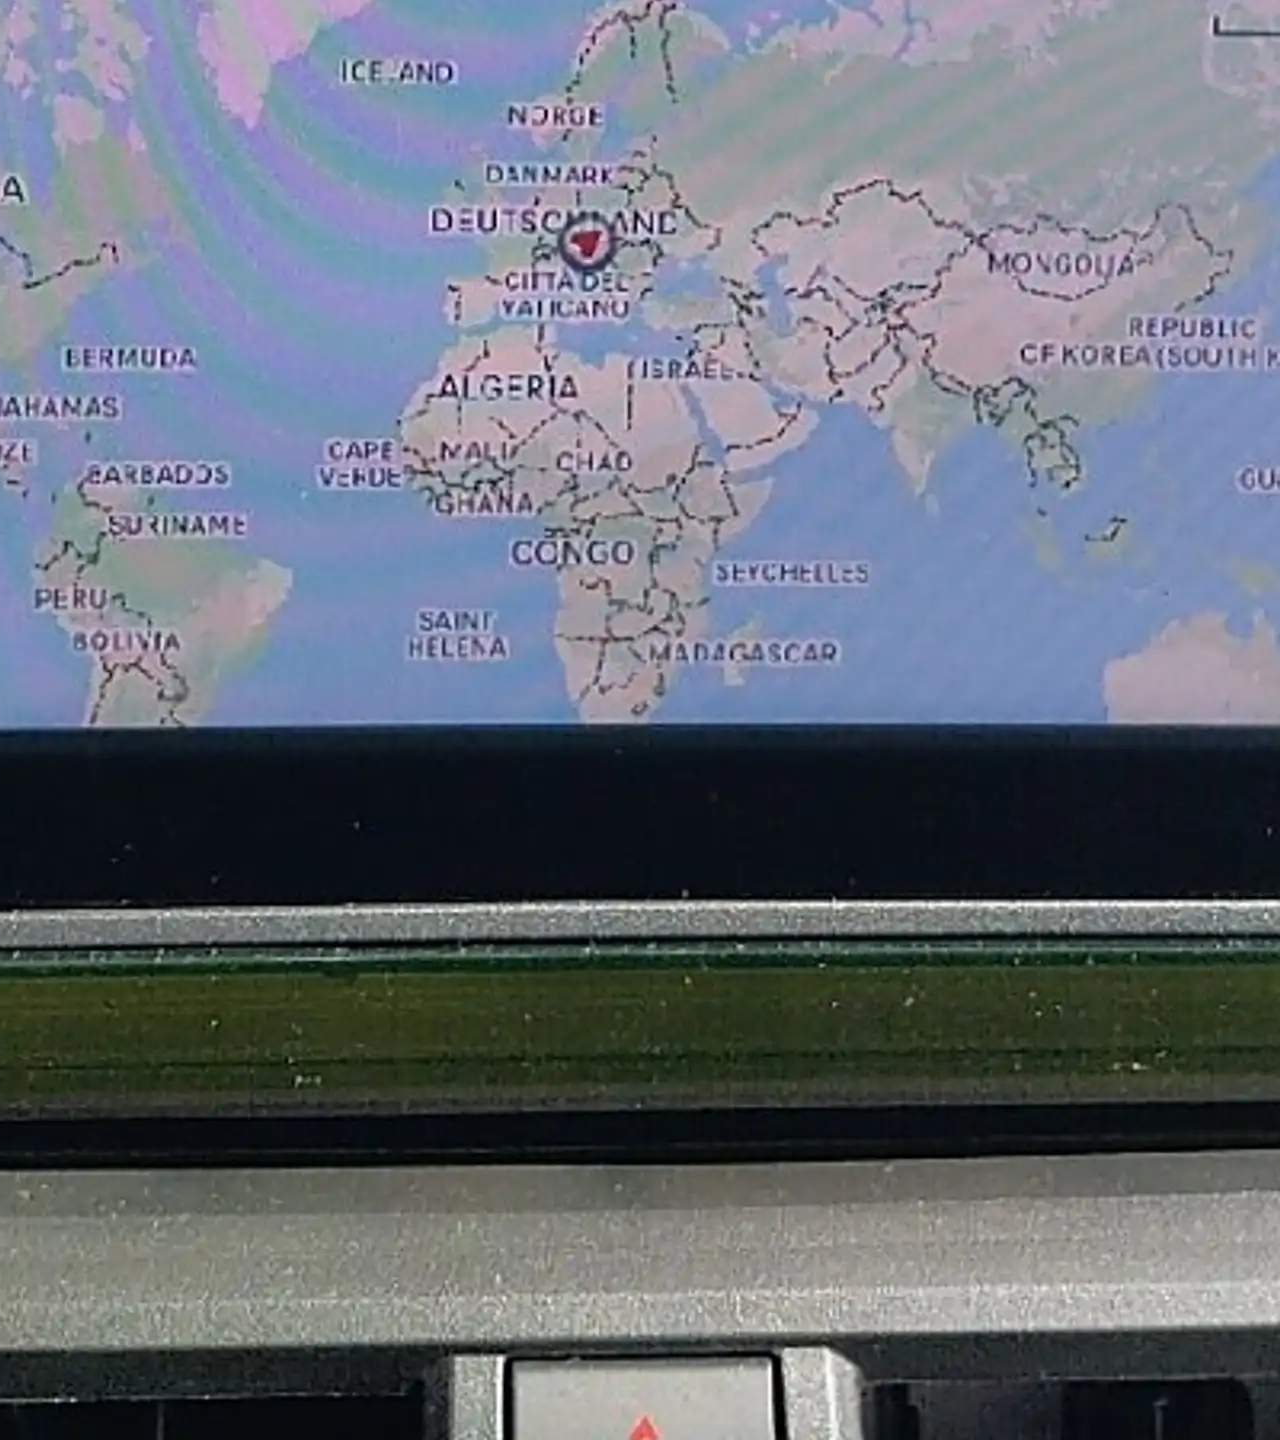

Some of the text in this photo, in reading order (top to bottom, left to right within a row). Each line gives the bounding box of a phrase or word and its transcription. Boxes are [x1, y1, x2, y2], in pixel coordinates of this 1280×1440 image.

[340, 62, 454, 84] ICELAND
[507, 105, 603, 127] NORGE
[486, 164, 613, 184] DANMARK
[987, 254, 1135, 276] MONGOLIA
[582, 271, 629, 292] DEL
[502, 300, 629, 319] VATICANO
[1129, 318, 1256, 338] REPUBLIC
[66, 347, 197, 369] BERMUDA
[1020, 343, 1055, 366] OF
[1062, 344, 1149, 367] KOREA
[642, 359, 734, 380] ISRAEL
[438, 375, 579, 400] ALGERIA
[329, 441, 394, 460] CAPE
[441, 441, 510, 460] MALI
[557, 451, 633, 472] CHAD
[89, 465, 230, 485] BARBADOS
[320, 467, 402, 488] VERDE
[435, 492, 533, 514] GHANA
[108, 515, 246, 536] SURINAME
[511, 540, 635, 566] CONGO
[716, 562, 869, 583] SEYCHELLES
[35, 588, 107, 609] PERU
[420, 611, 492, 632] SAINT
[73, 631, 181, 652] BOLIVIA
[408, 636, 508, 659] HELENA
[648, 641, 837, 662] MADAGASCAR
